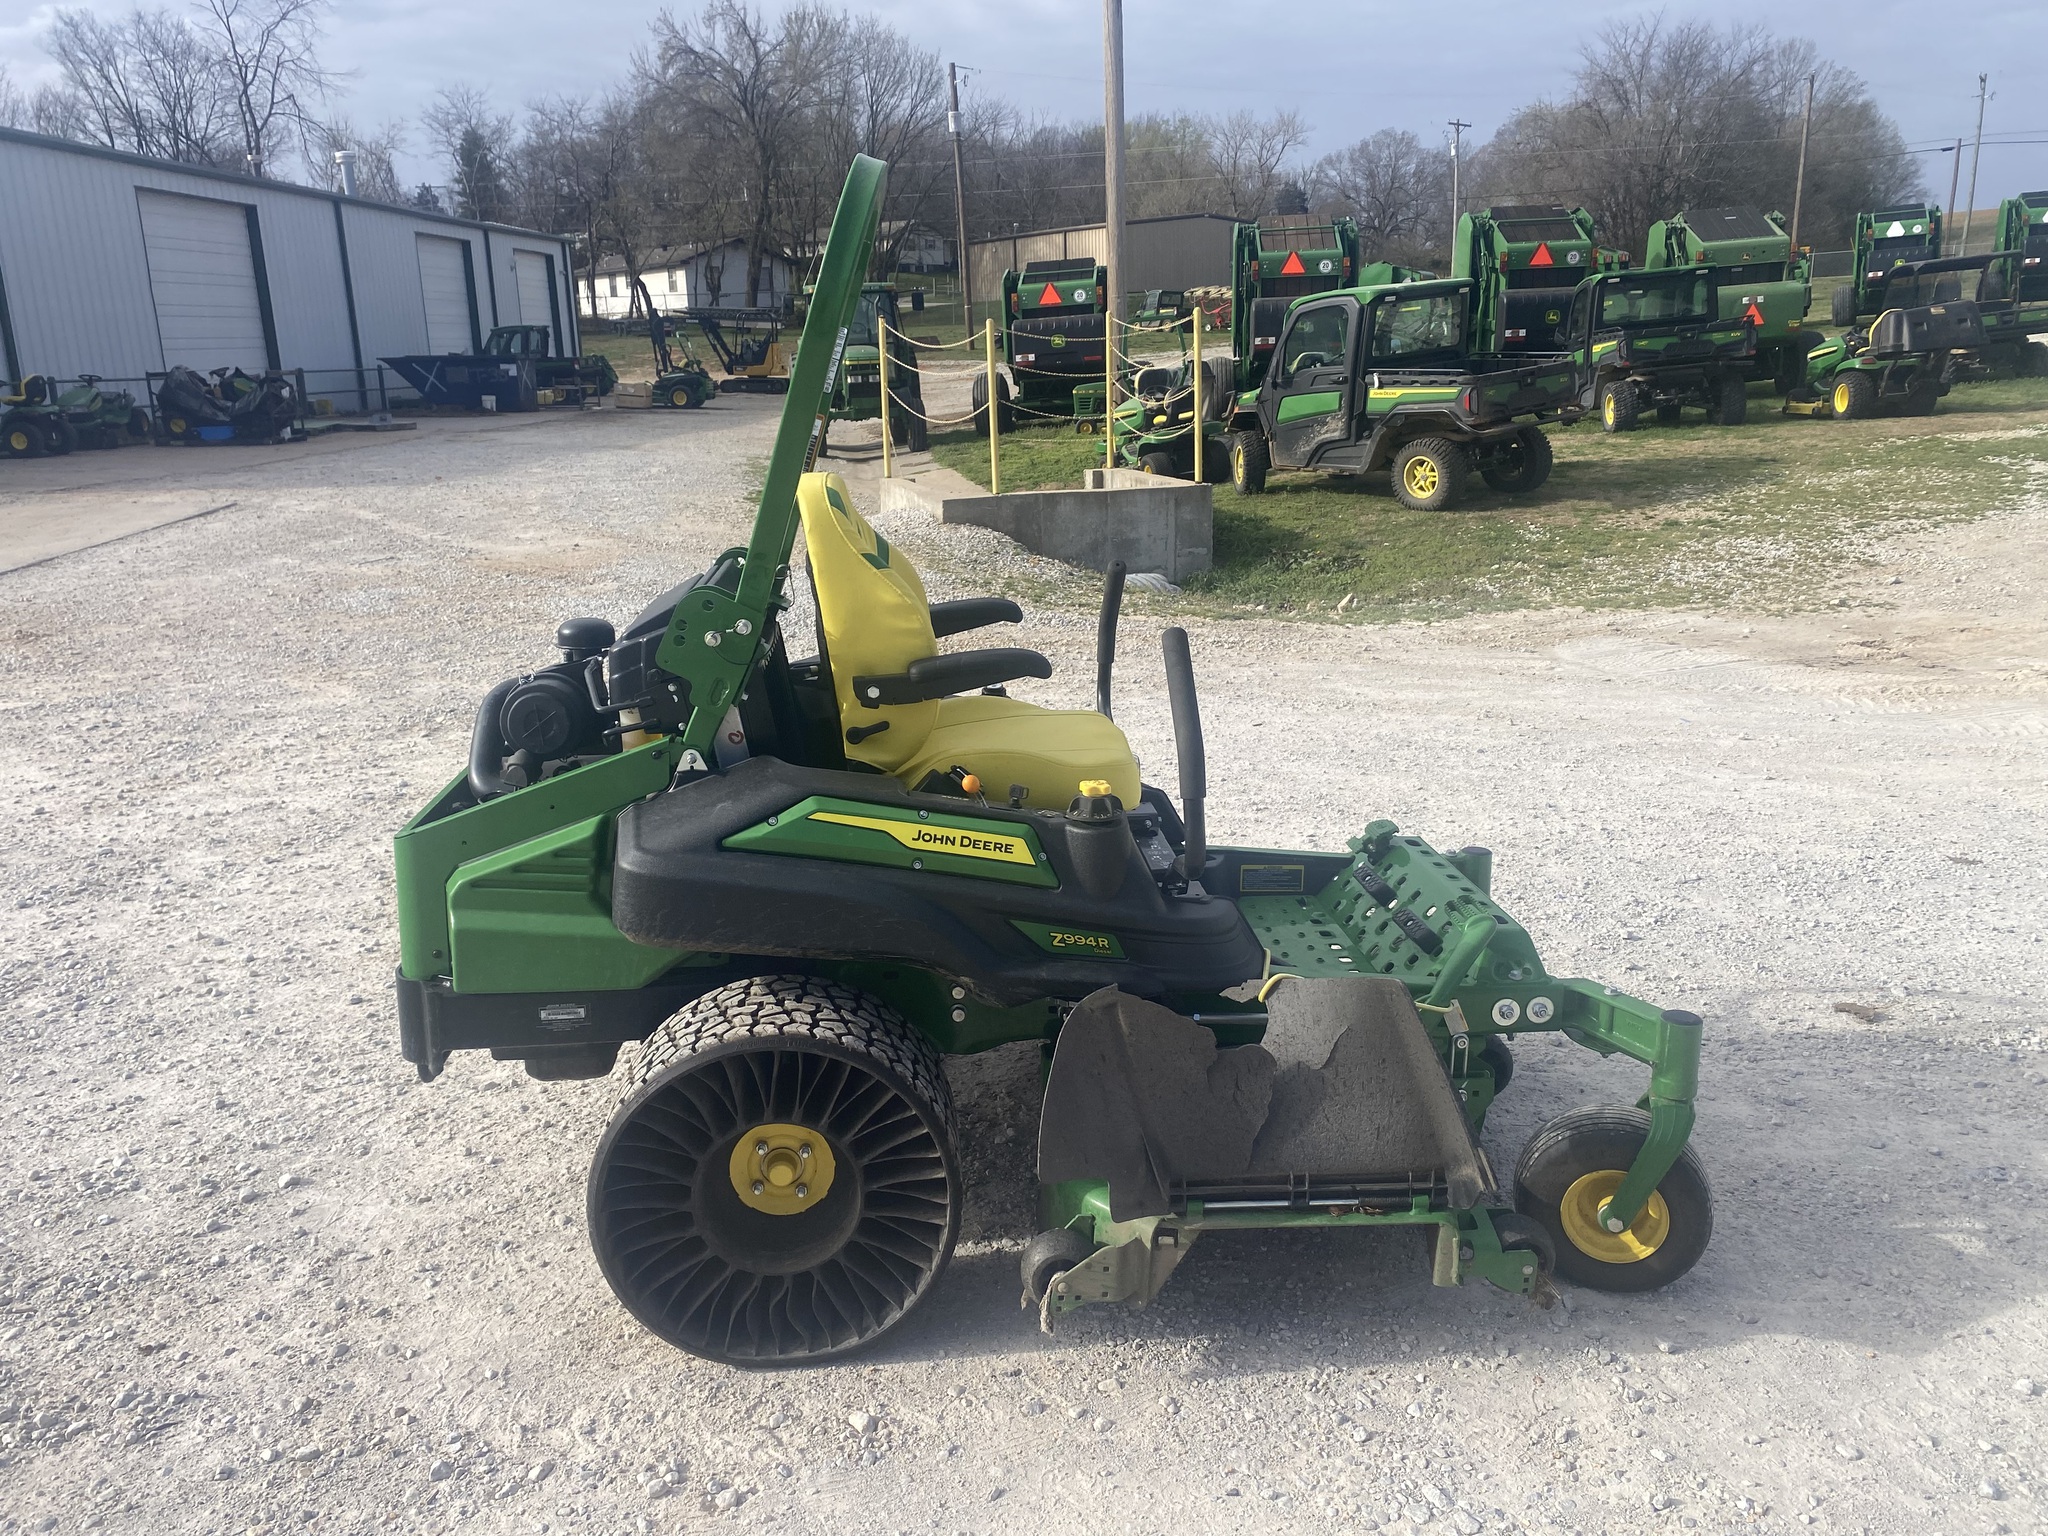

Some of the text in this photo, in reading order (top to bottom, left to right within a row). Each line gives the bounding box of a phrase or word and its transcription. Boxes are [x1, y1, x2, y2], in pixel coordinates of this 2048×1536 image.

[911, 829, 1015, 855] JOHN DEERE
[1049, 932, 1110, 949] Z994R
